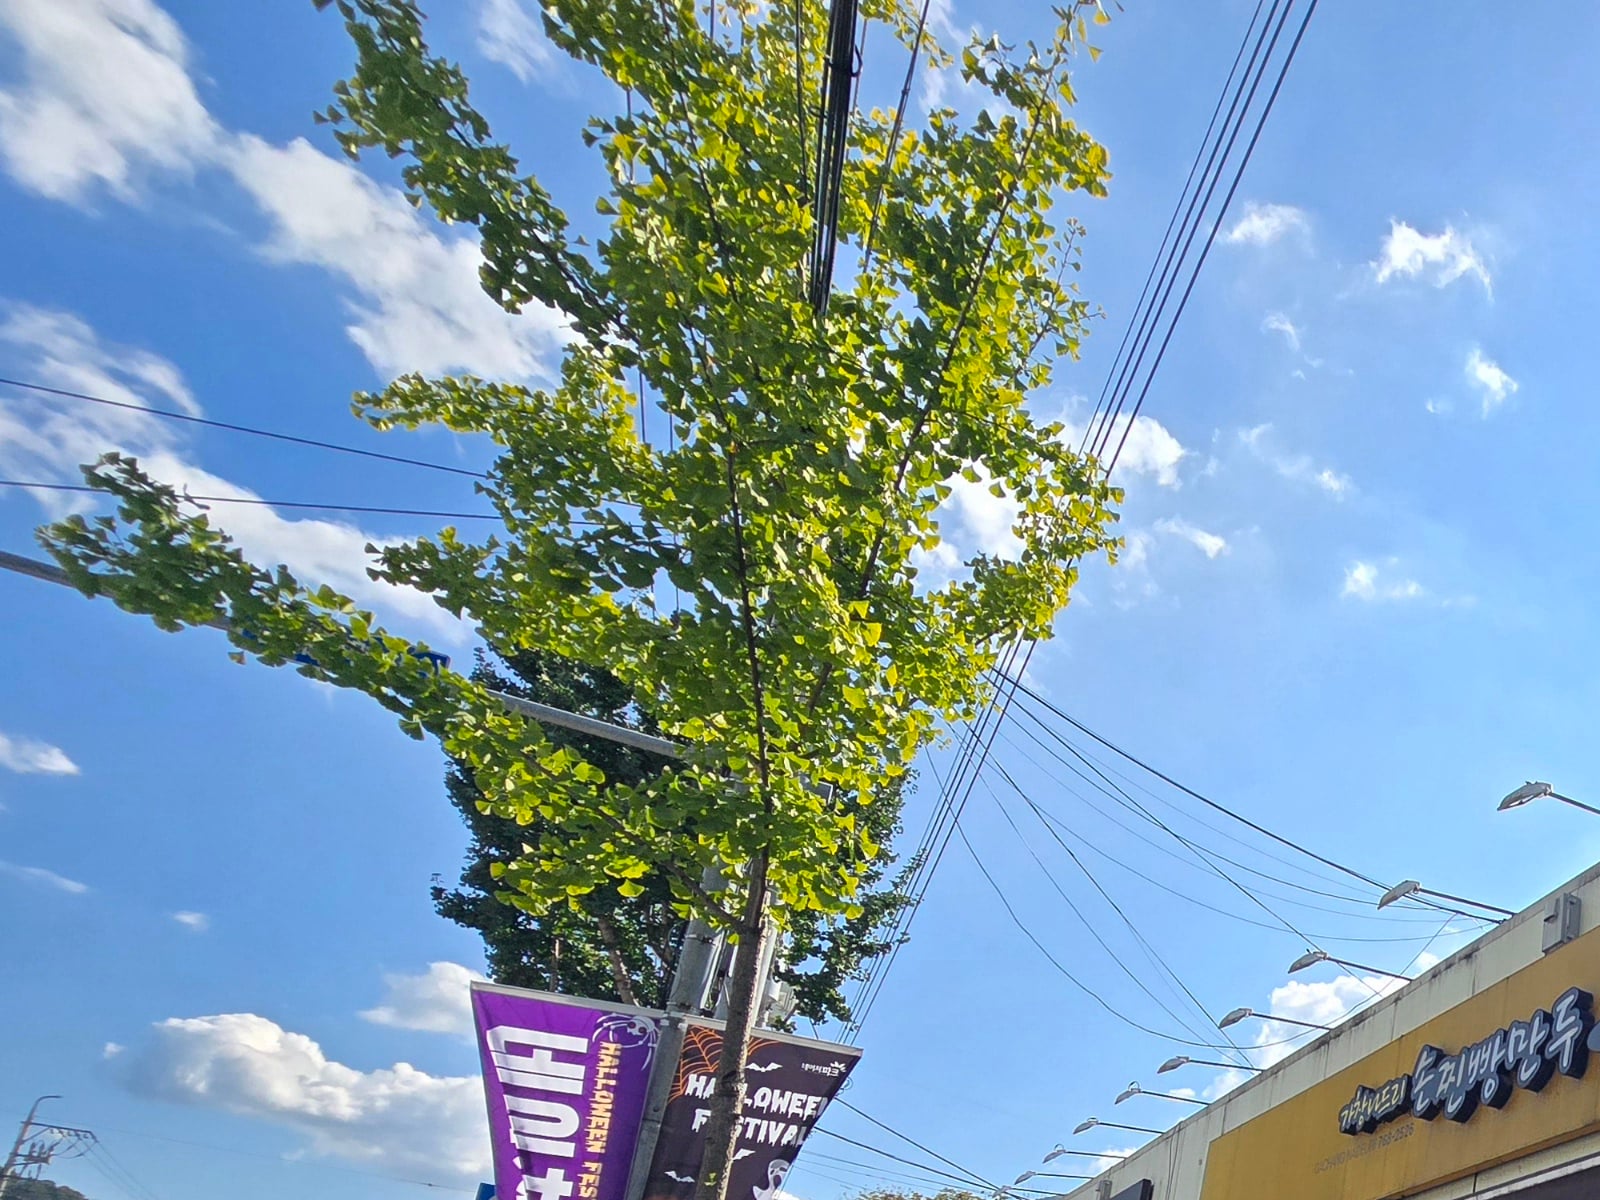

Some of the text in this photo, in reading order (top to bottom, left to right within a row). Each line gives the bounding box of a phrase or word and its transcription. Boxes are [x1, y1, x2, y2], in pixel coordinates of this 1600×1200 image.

[587, 1041, 621, 1154] HALLOWEEN
[685, 1073, 829, 1121] HALOWEE
[691, 1108, 807, 1148] FSTIVAL
